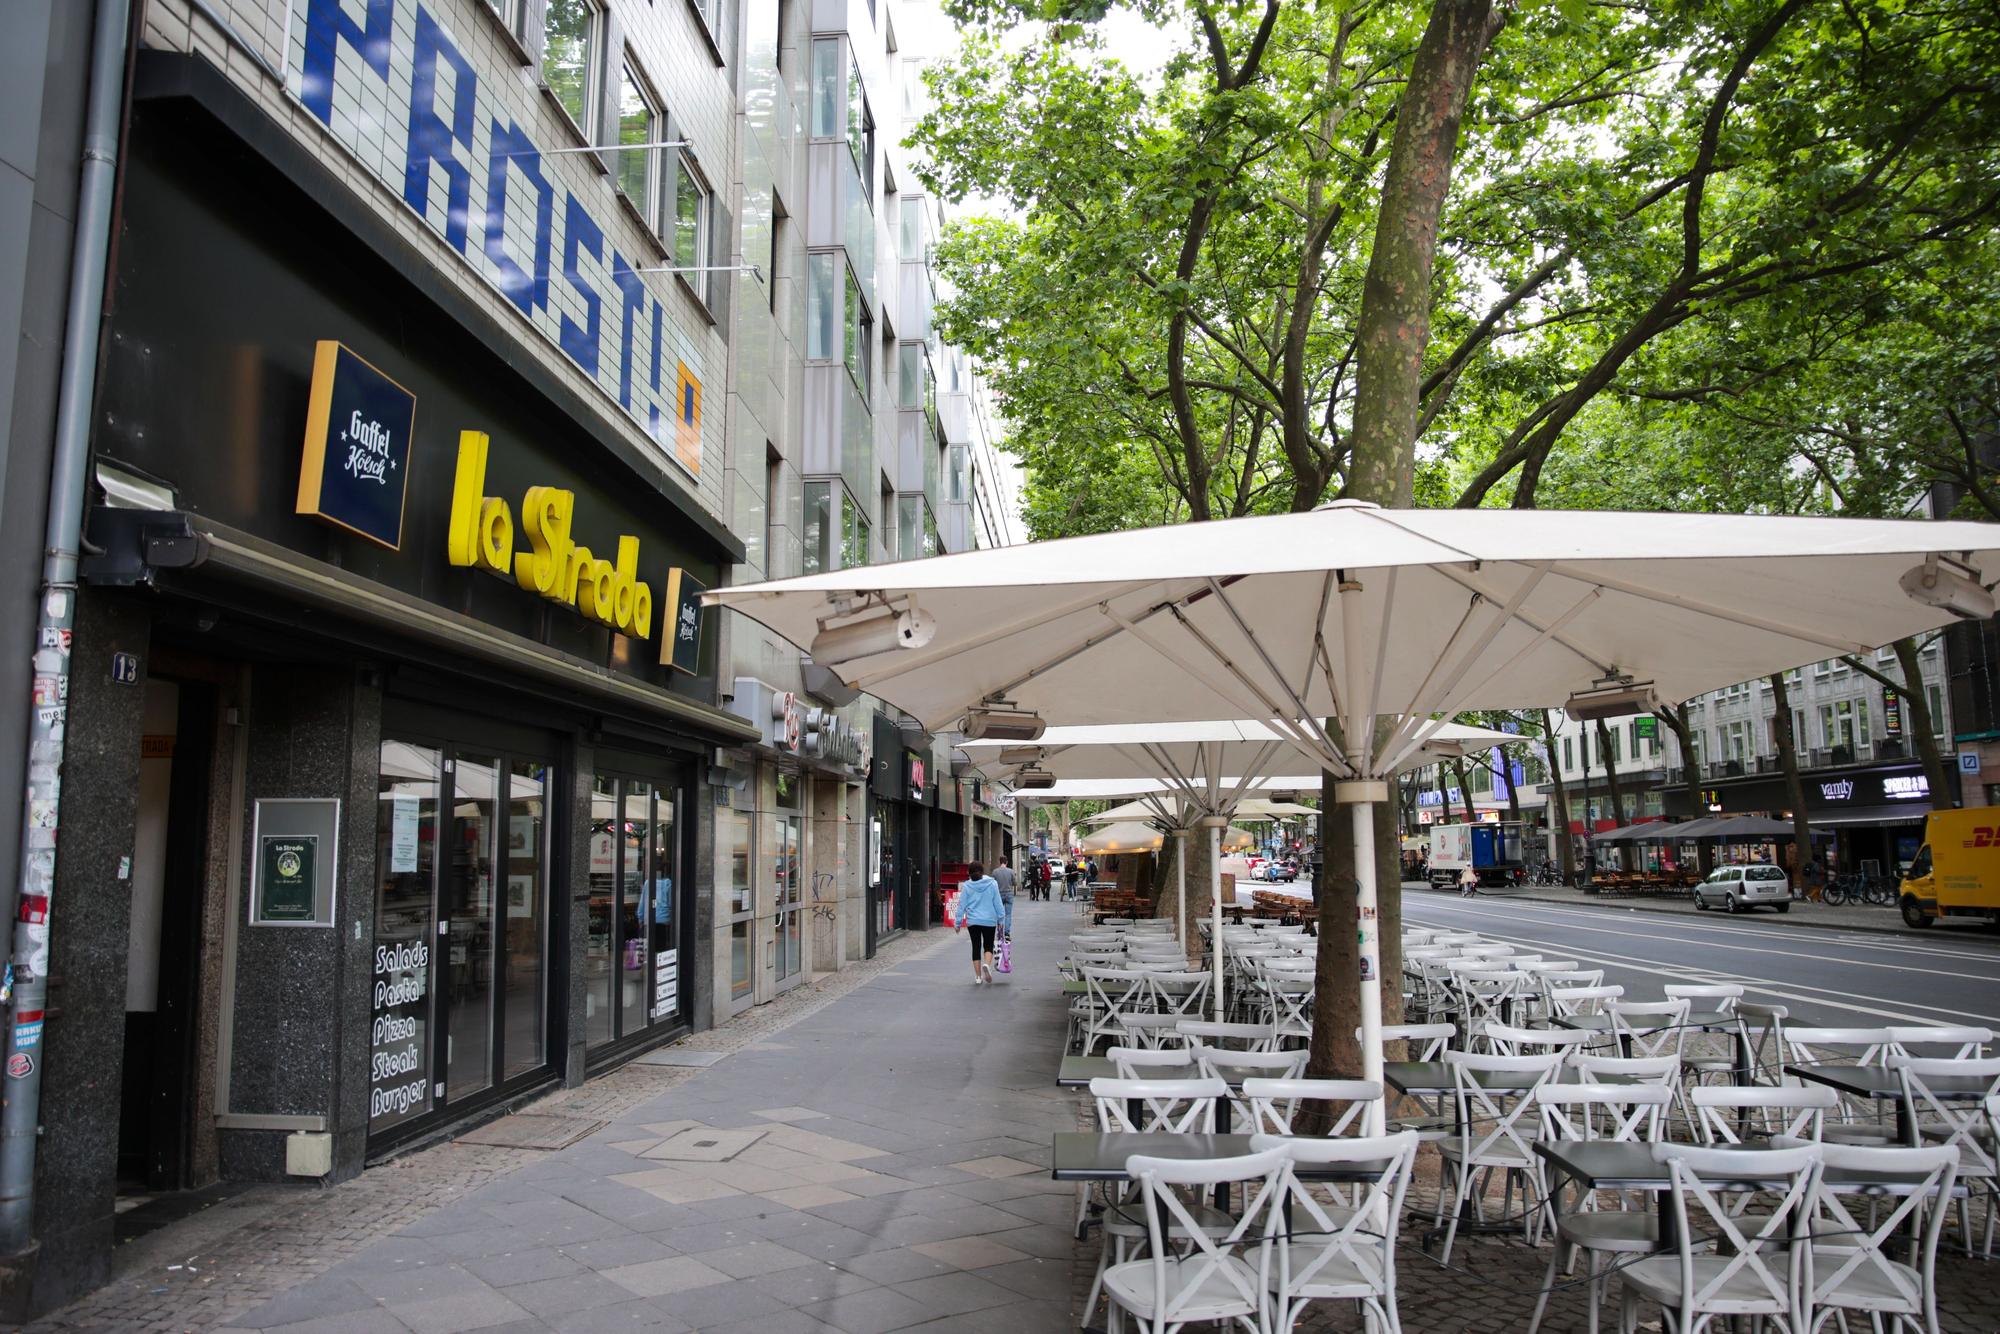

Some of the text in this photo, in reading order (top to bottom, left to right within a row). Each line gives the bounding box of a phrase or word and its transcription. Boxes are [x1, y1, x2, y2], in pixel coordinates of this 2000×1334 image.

[350, 409, 391, 459] Gaffel
[344, 445, 386, 485] Kölsch
[514, 486, 652, 640] Strada
[119, 655, 137, 682] 13
[376, 941, 428, 974] Salads
[374, 977, 419, 1010] Pasta
[373, 1013, 416, 1046] Pizza
[372, 1043, 418, 1082] Steak
[371, 1078, 427, 1118] Burger
